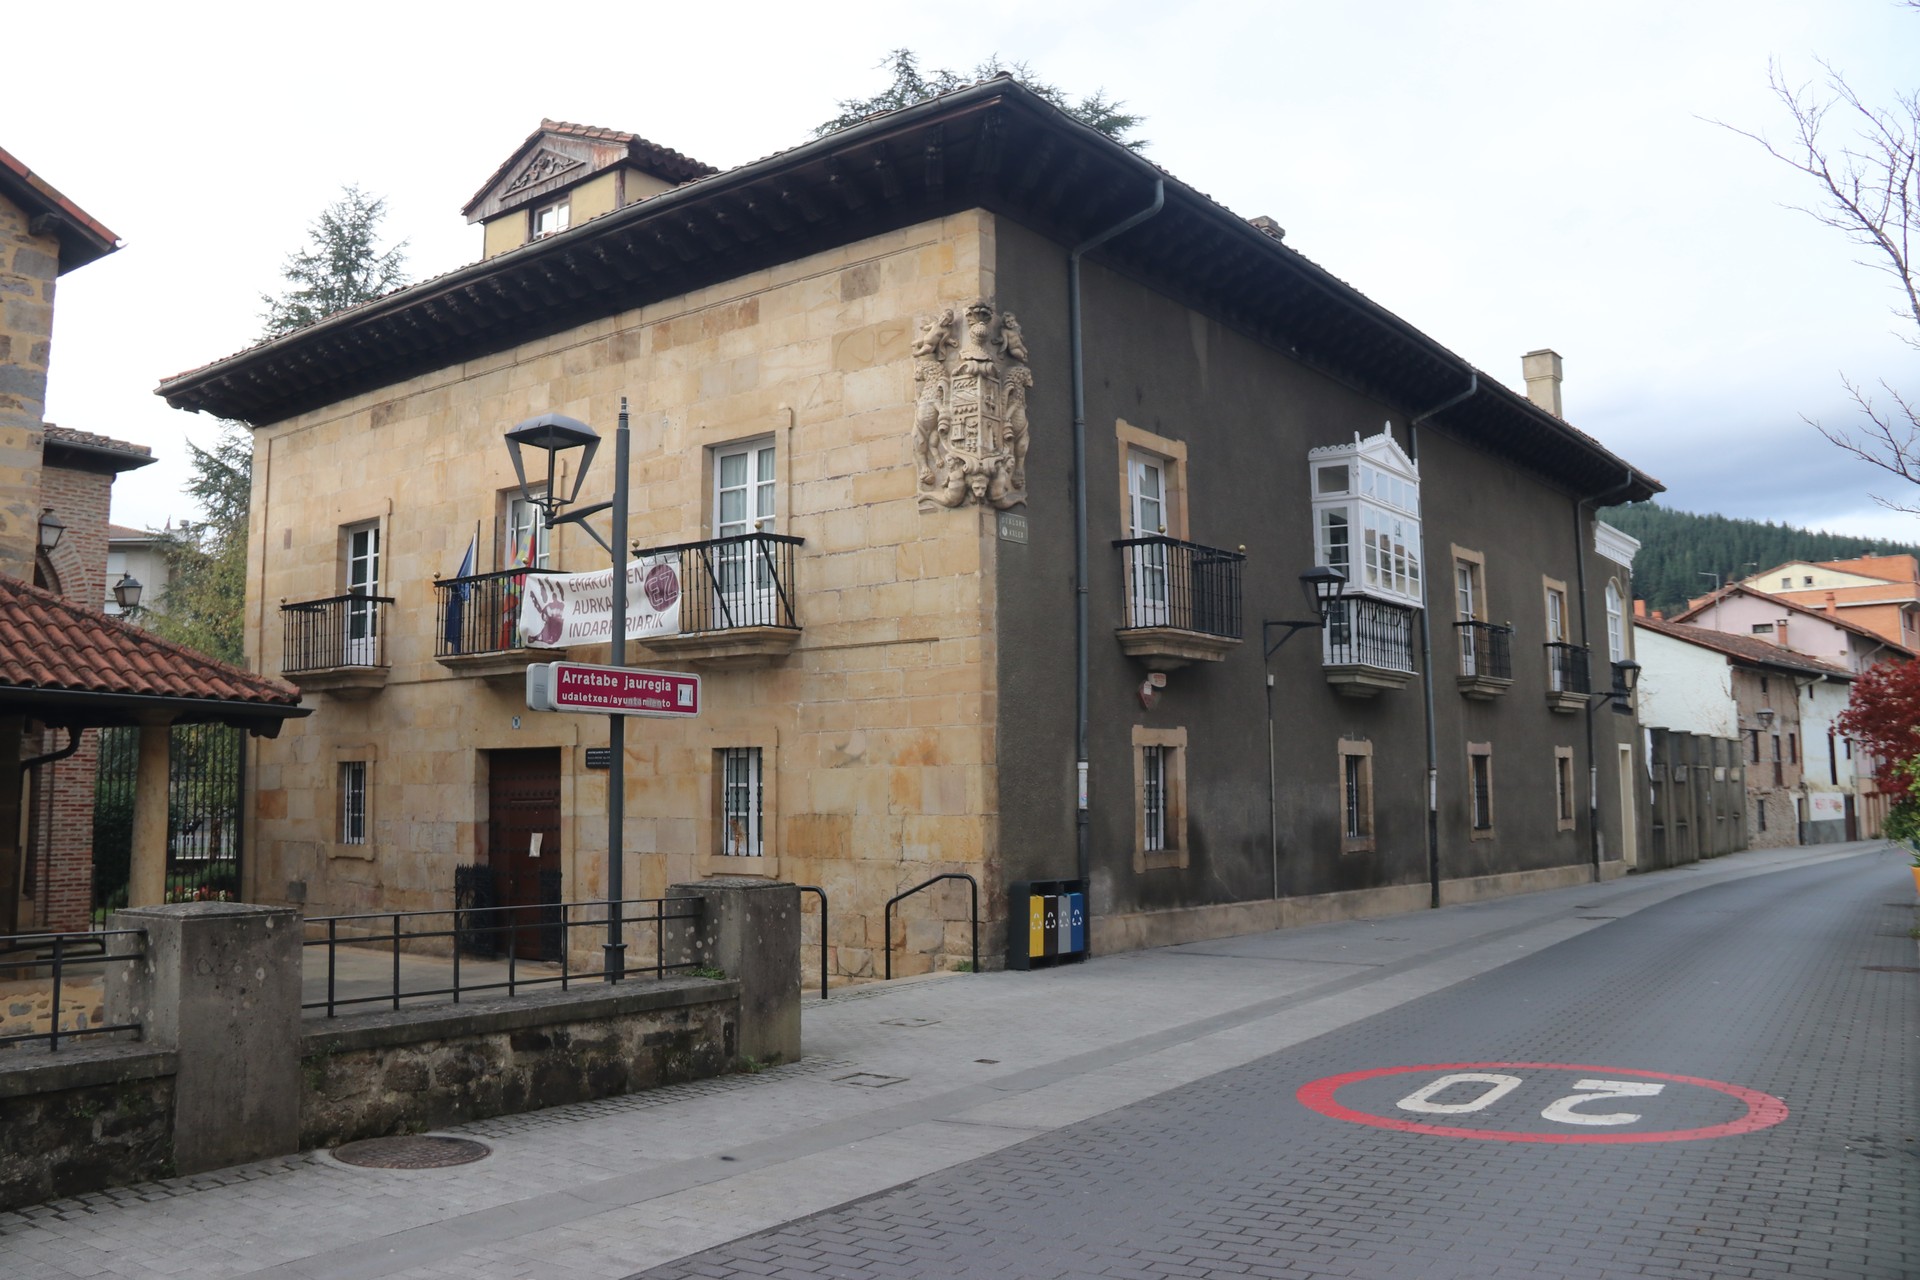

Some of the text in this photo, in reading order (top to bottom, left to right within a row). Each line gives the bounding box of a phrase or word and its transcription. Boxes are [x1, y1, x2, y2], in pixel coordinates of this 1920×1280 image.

[568, 567, 644, 592] EMAKUMEN
[645, 570, 677, 607] EZ
[562, 670, 671, 693] Arratabe jauregia
[562, 692, 608, 704] udaletxea
